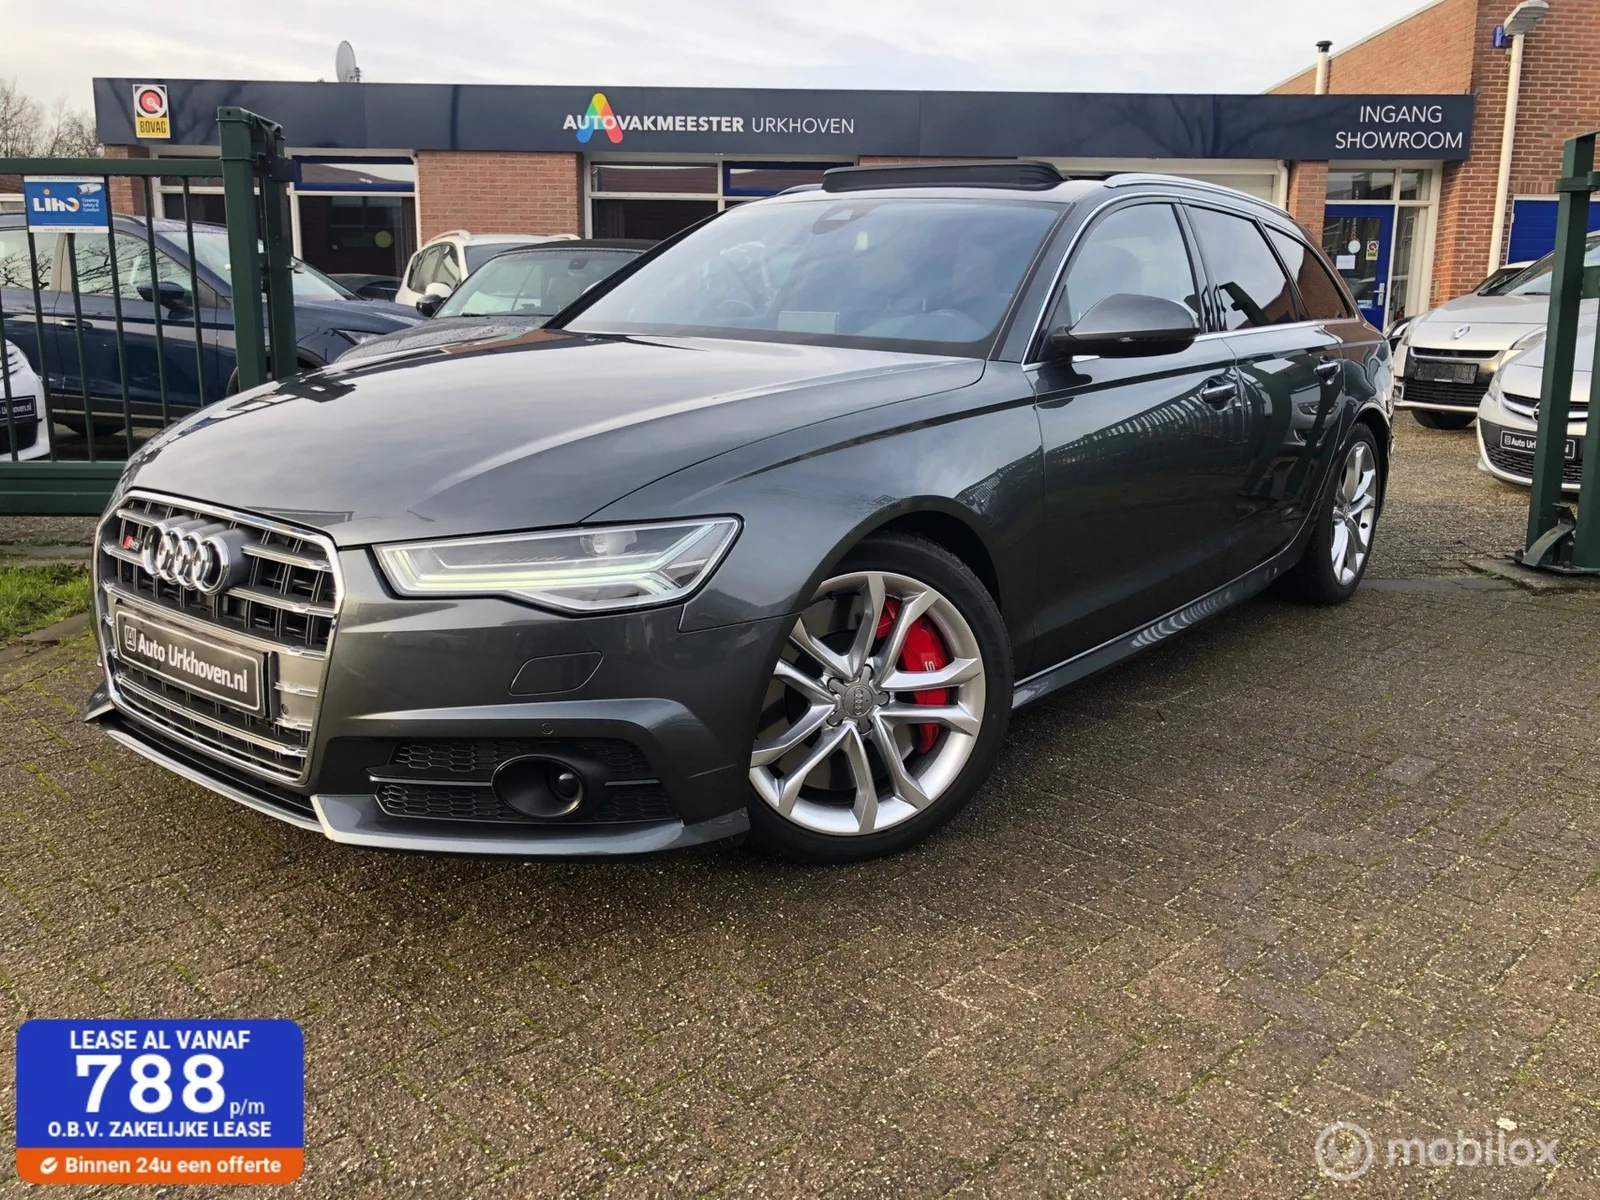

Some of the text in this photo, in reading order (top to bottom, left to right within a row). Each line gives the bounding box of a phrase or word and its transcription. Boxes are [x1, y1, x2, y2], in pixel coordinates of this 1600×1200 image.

[1359, 105, 1442, 123] INGANG
[140, 120, 167, 134] BOVAG
[562, 114, 855, 134] AUTOVAKMEESTER URKHOVEN
[1335, 131, 1463, 149] SHOWROOM
[1511, 437, 1526, 448] Auto
[138, 633, 248, 693] Auto Urkhoven.nl
